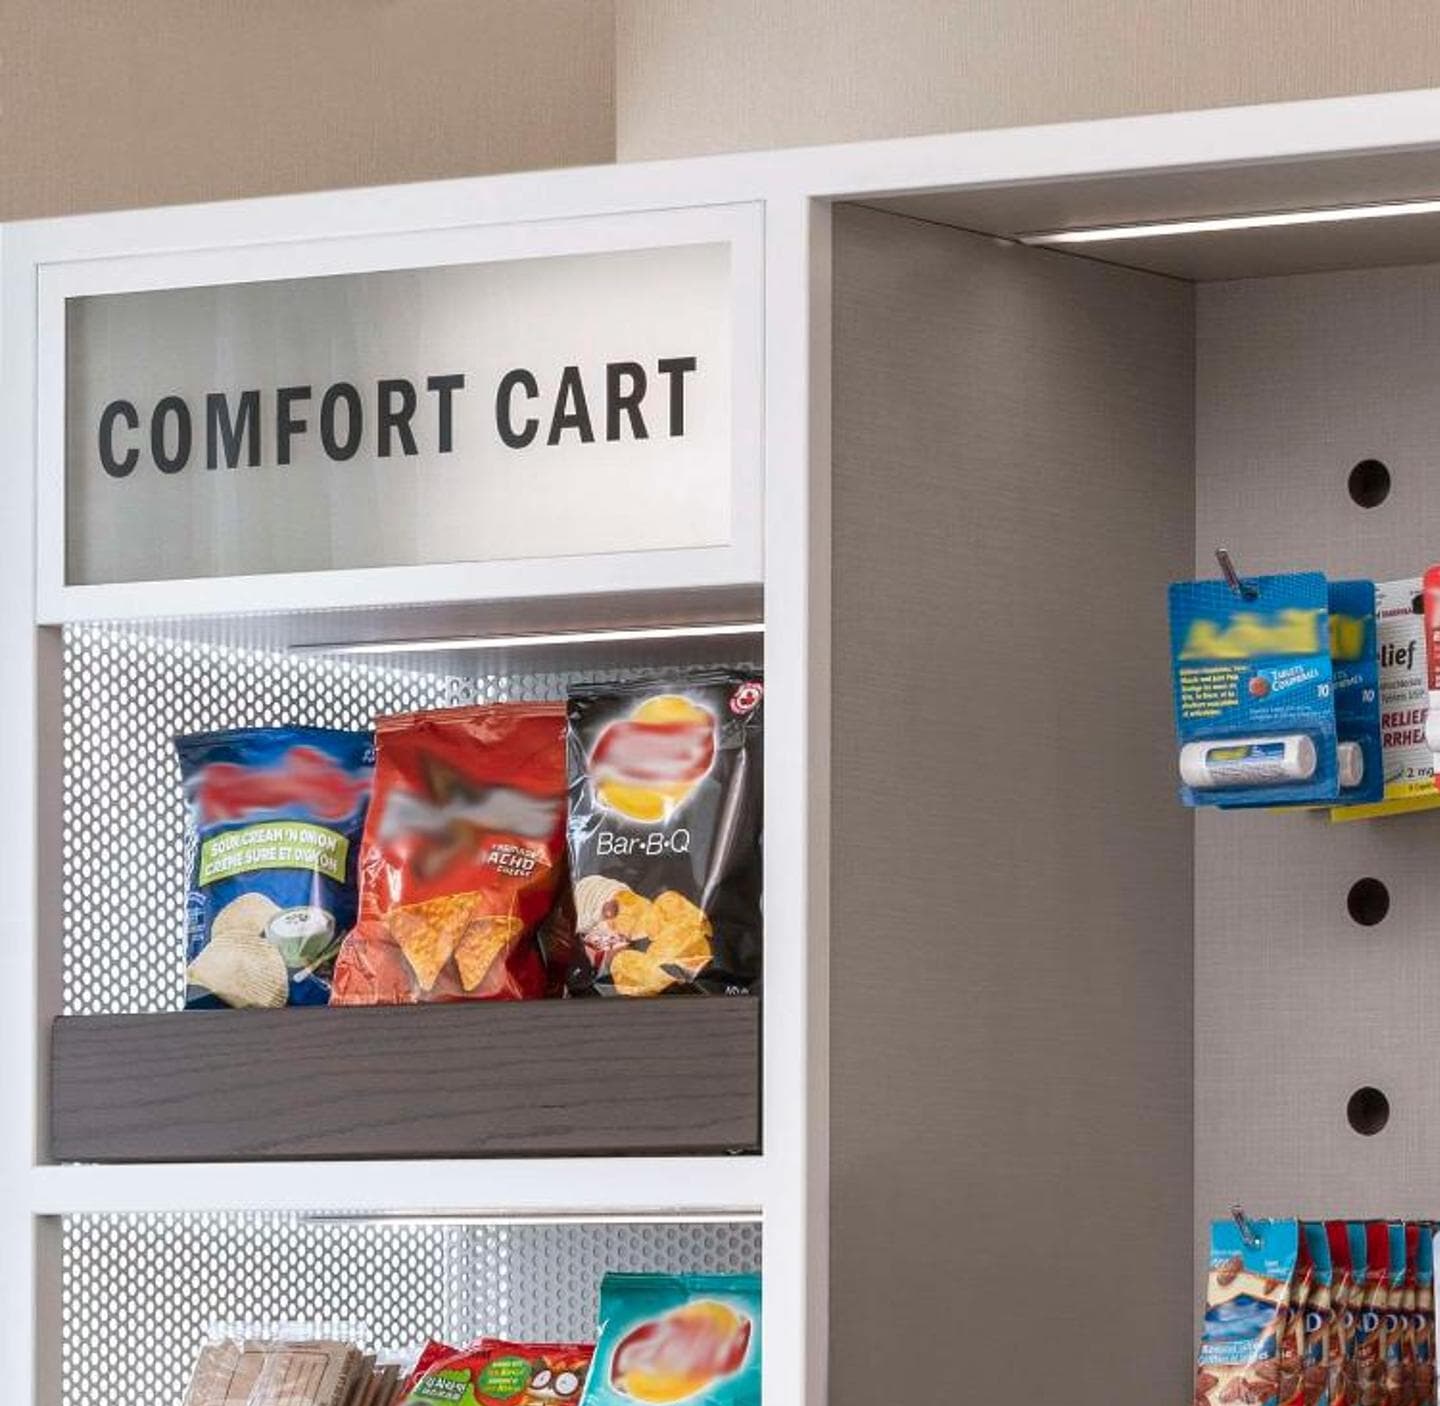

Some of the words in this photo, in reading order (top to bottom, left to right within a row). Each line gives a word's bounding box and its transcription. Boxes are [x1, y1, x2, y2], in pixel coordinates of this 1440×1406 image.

[99, 374, 465, 478] COMFORT
[495, 356, 697, 450] CART
[1380, 640, 1417, 670] lief
[1317, 683, 1329, 698] 10
[1383, 728, 1427, 748] RRHEA
[488, 851, 535, 871] ACHO
